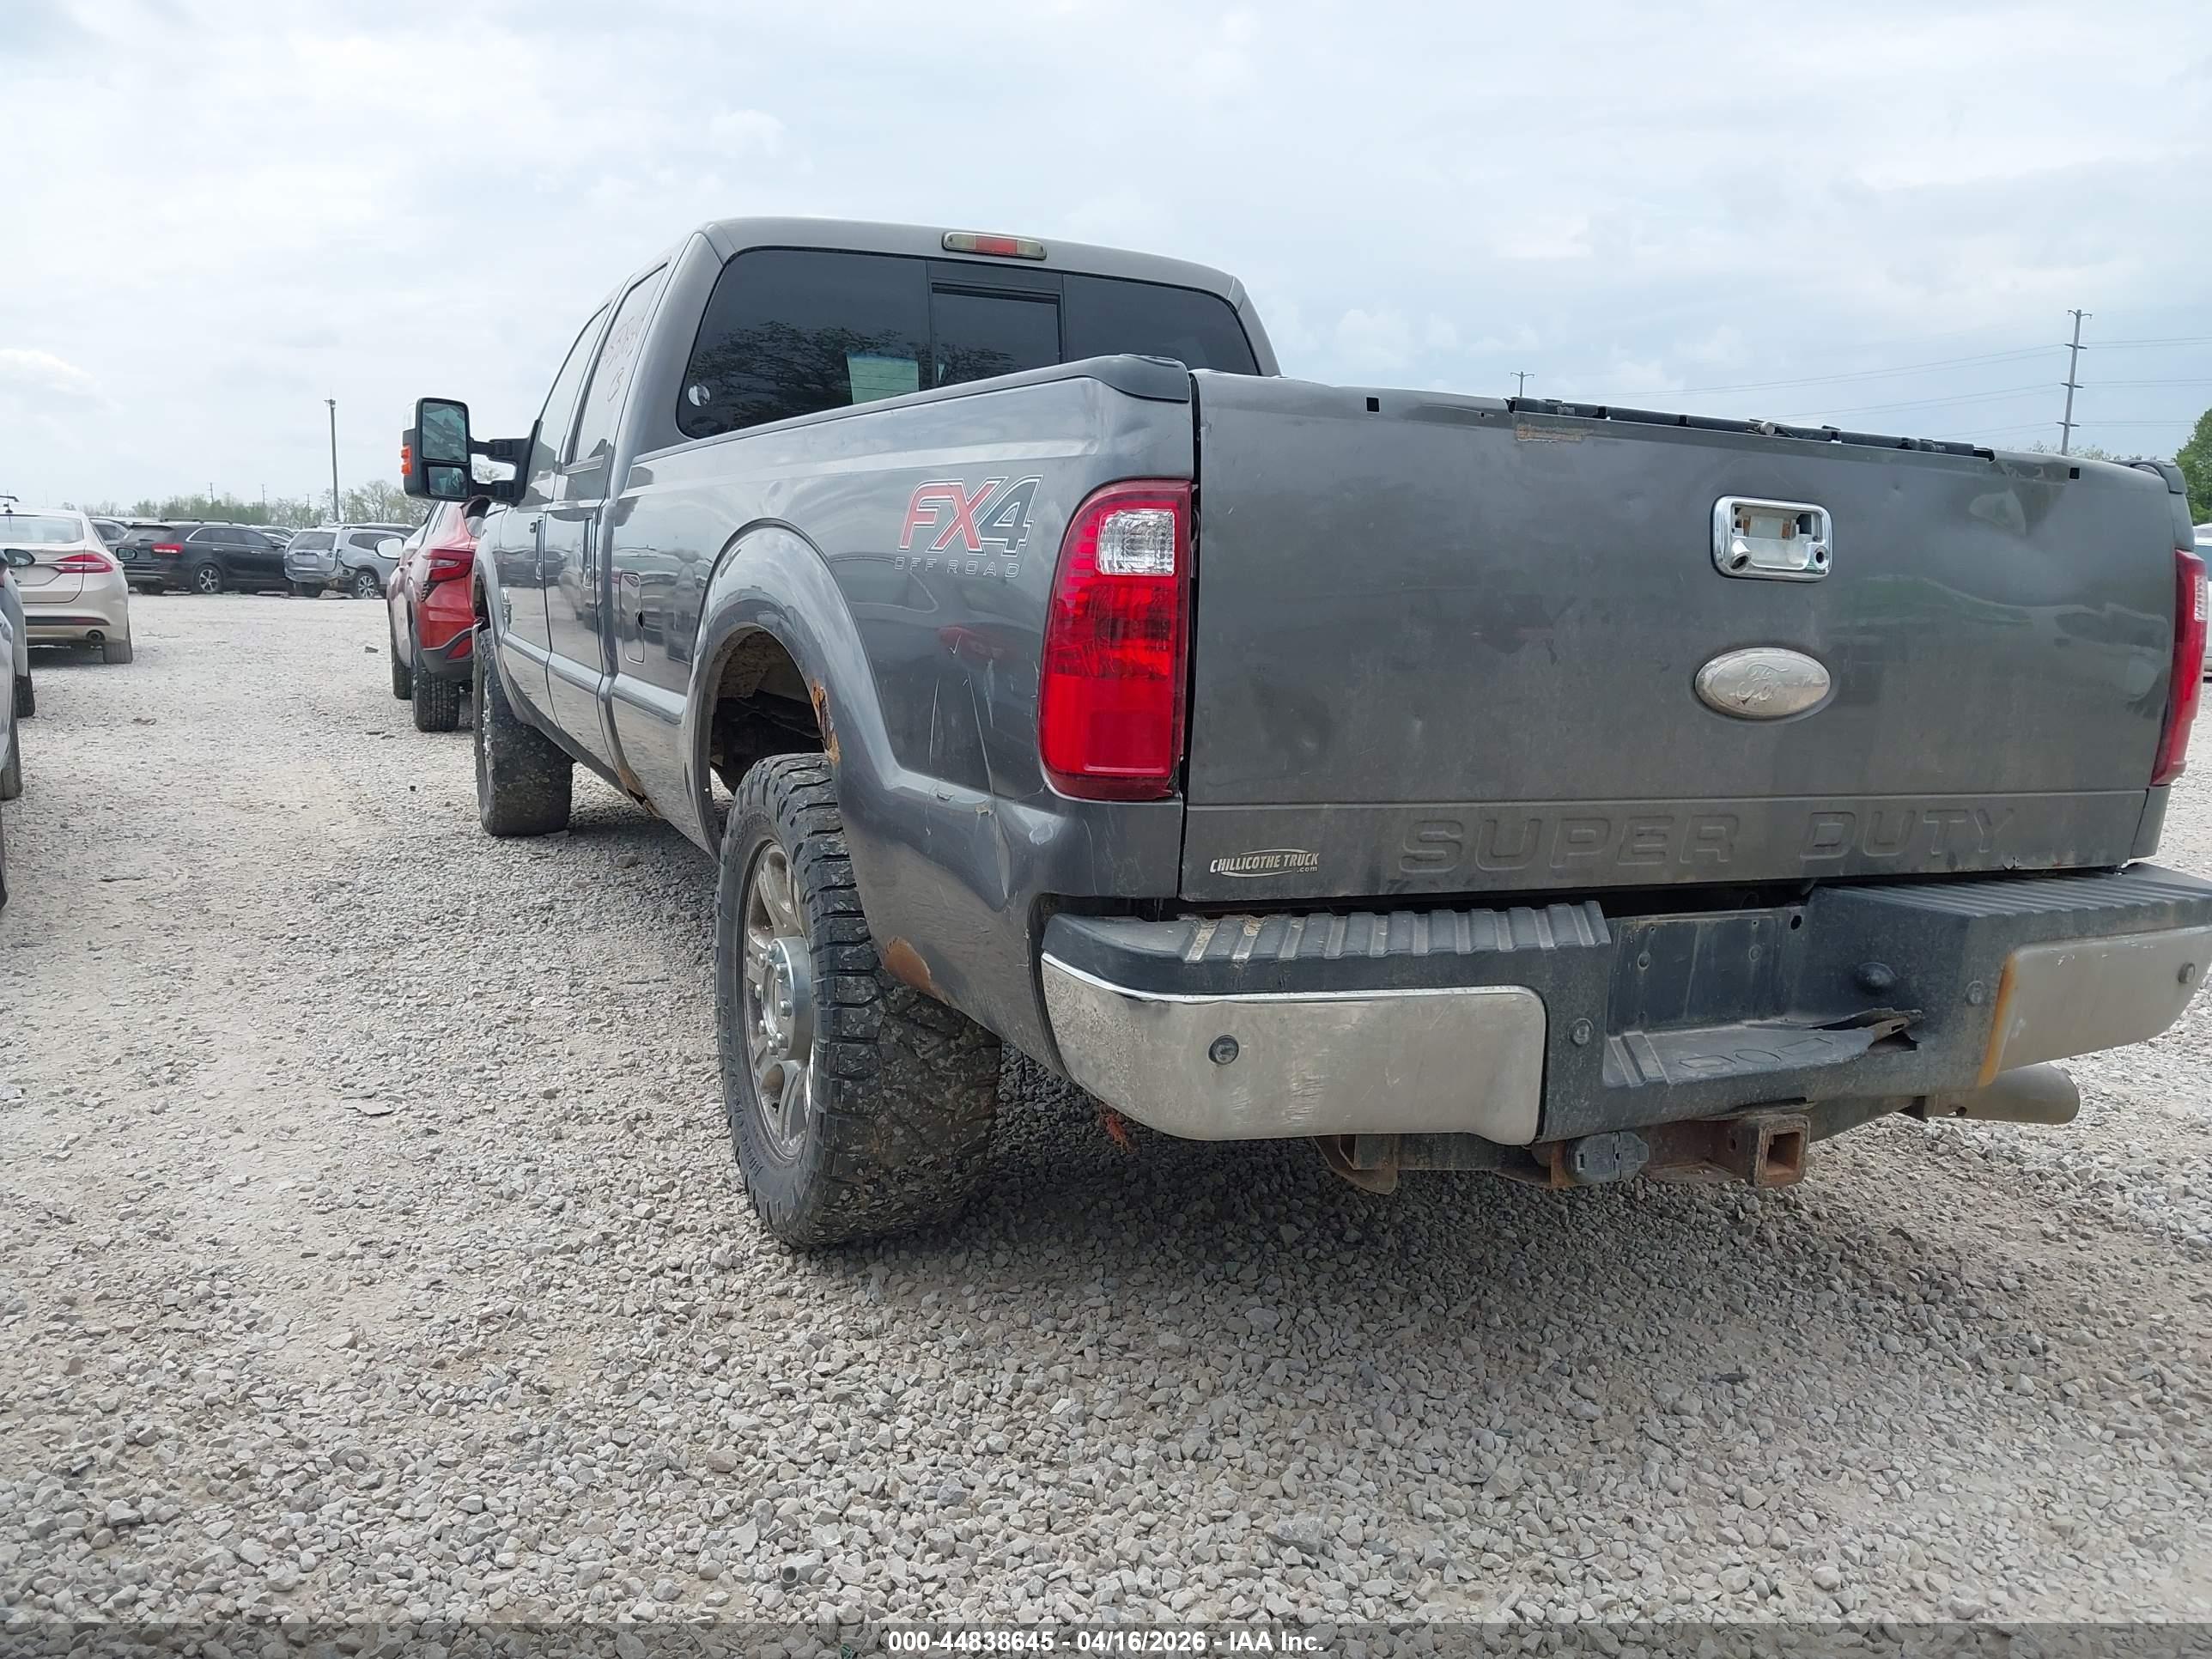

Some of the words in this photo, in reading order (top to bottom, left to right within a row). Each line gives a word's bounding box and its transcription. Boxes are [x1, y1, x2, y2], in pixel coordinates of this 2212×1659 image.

[897, 474, 1043, 557] FX4
[894, 556, 937, 571] OFF
[947, 559, 1020, 578] ROAD
[1399, 813, 1740, 873] SUPER
[1800, 807, 2014, 860] DUTY
[1209, 854, 1280, 873] CHILLICOTHE
[1284, 853, 1320, 867] TRUCK
